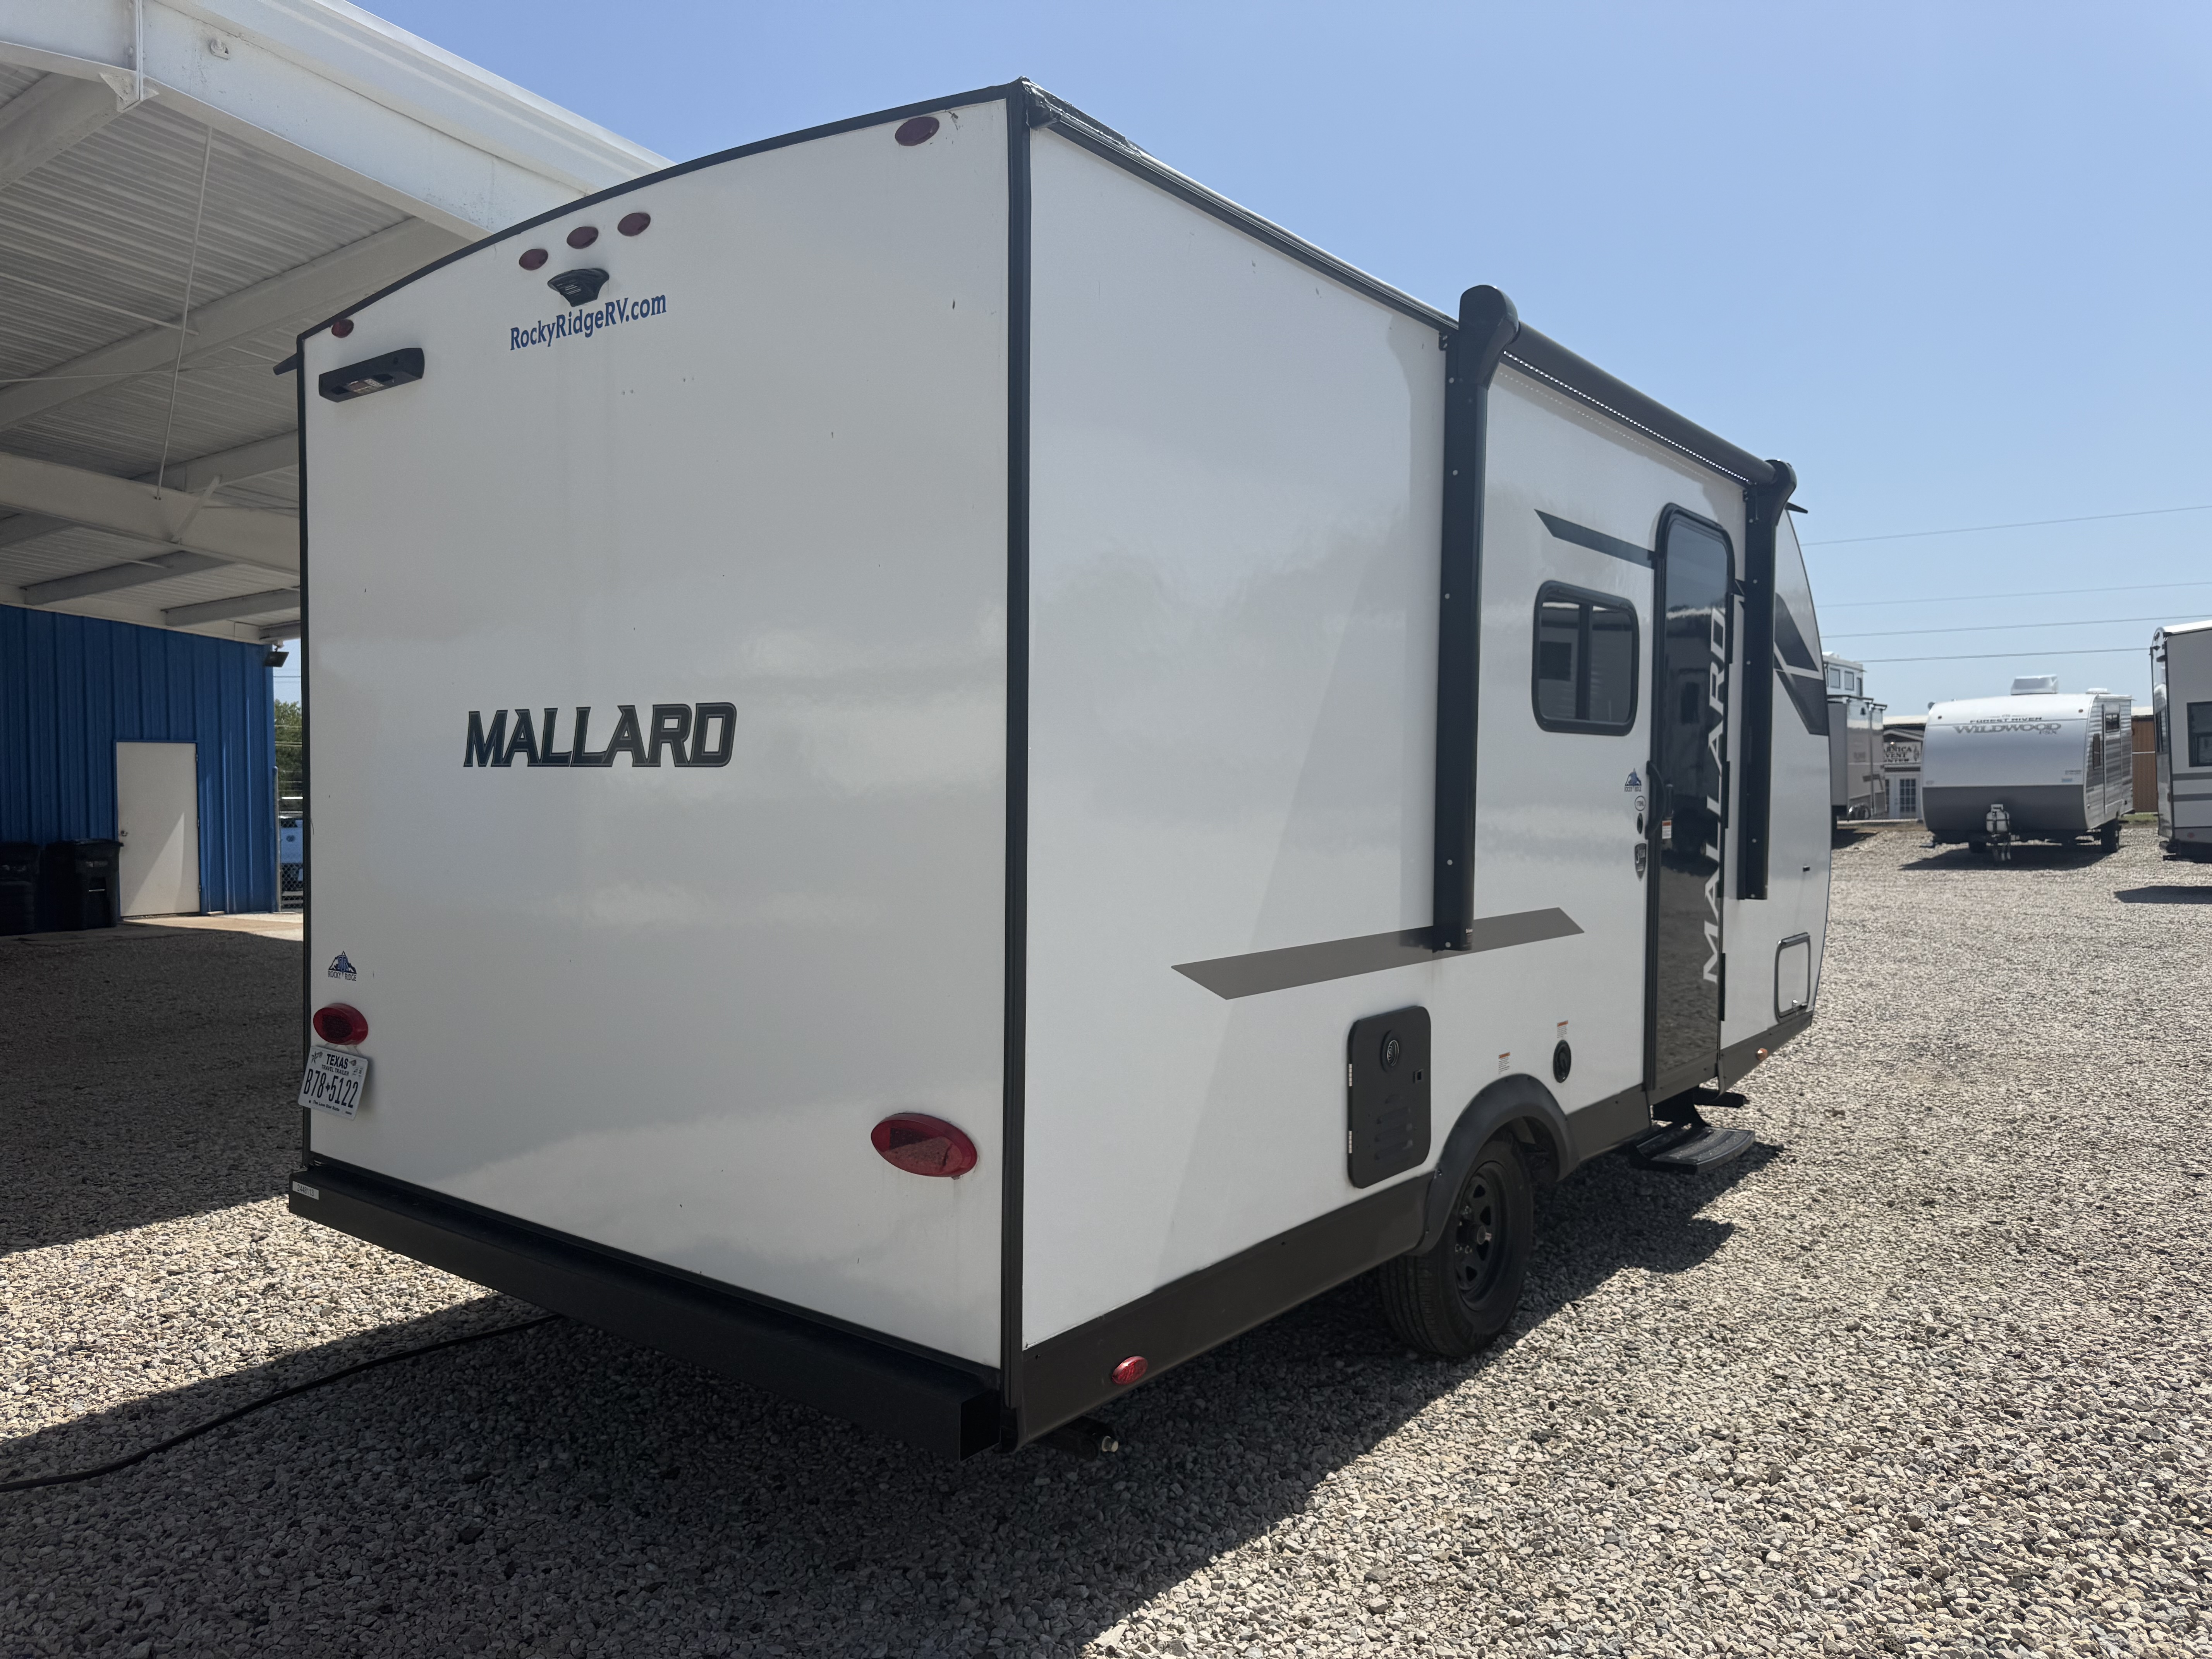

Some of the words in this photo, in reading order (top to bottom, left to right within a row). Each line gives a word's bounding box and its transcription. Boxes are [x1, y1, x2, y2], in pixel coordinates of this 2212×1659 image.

[510, 294, 666, 350] RockyRidgeRV.com
[464, 702, 737, 767] MALLARD
[1953, 723, 2061, 734] WILDWOOD
[1703, 607, 1726, 984] MALLARD
[328, 970, 341, 979] ROCKY
[345, 973, 357, 981] RIDGE
[326, 1053, 349, 1070] TEXAS
[321, 1064, 334, 1072] TRAVEL
[335, 1068, 349, 1076] TRAILER
[297, 1183, 314, 1197] 2448113
